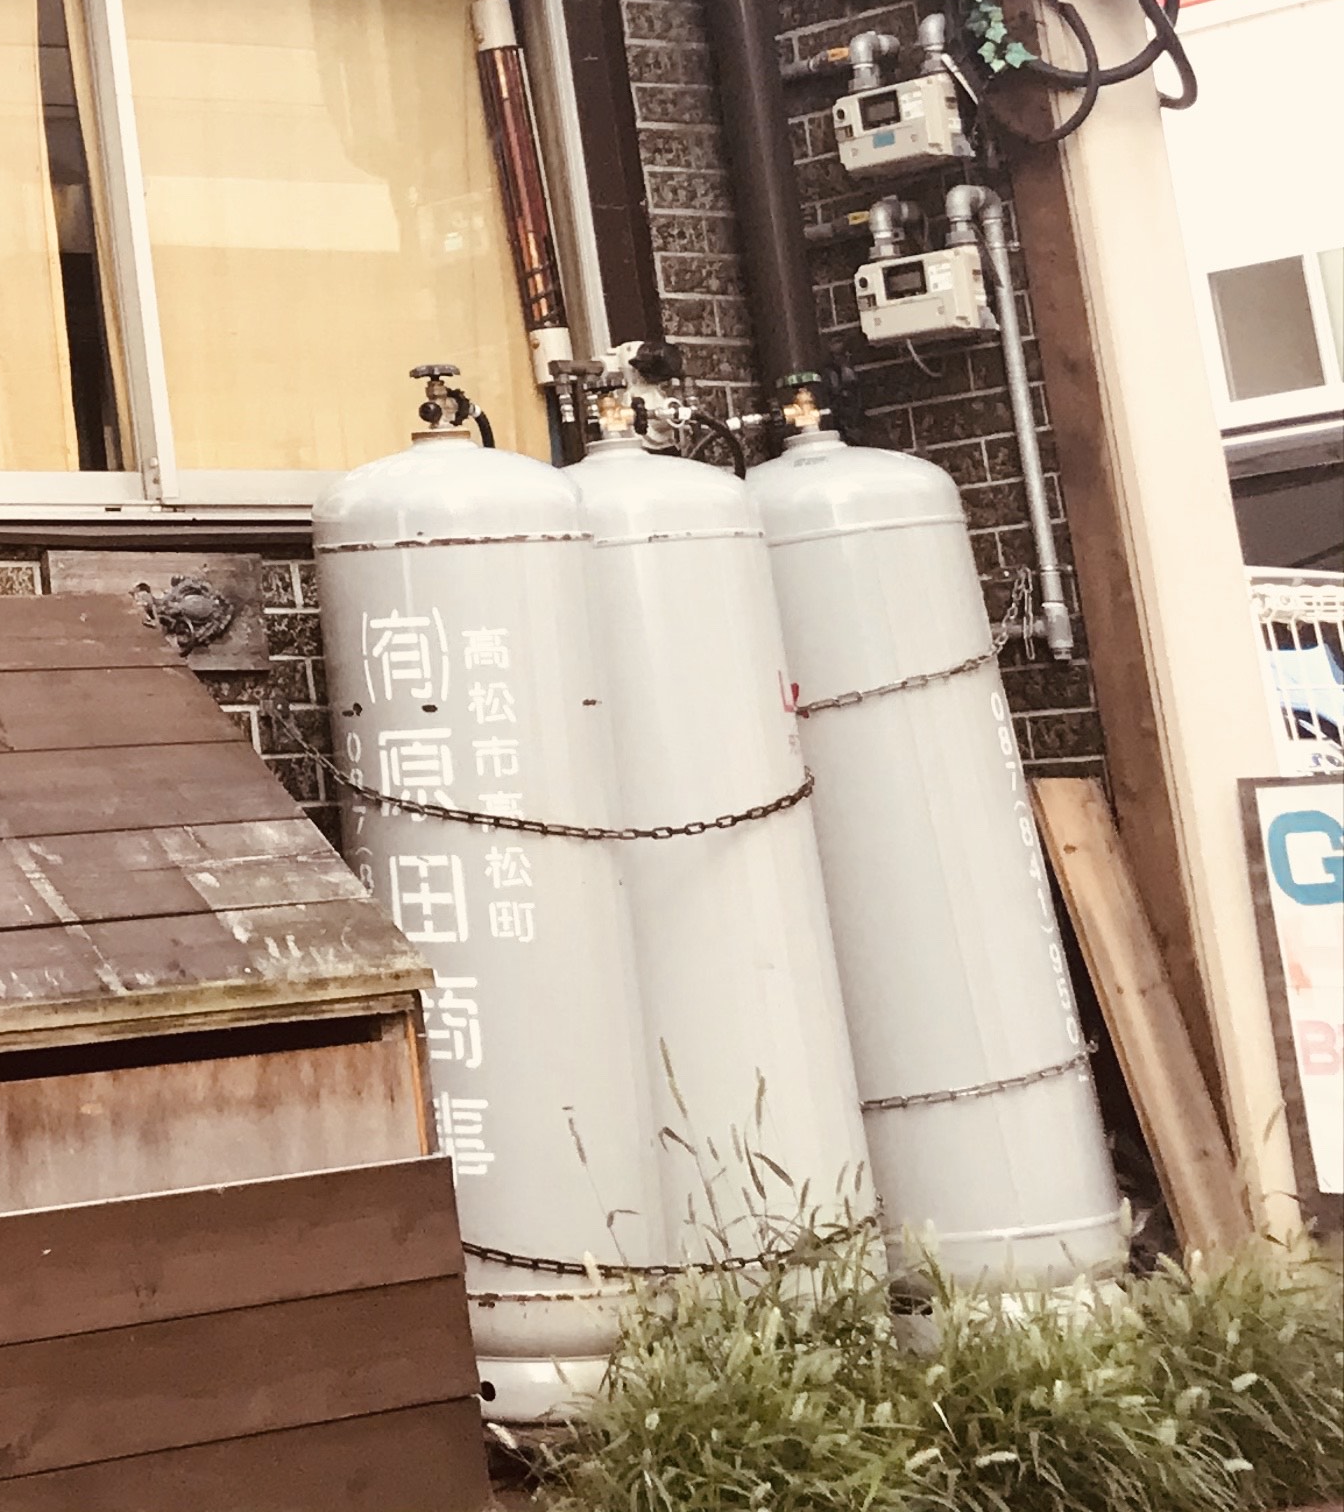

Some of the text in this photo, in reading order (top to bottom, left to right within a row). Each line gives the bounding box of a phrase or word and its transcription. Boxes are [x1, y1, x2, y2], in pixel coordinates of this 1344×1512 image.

[462, 624, 537, 944] 高松市高松町
